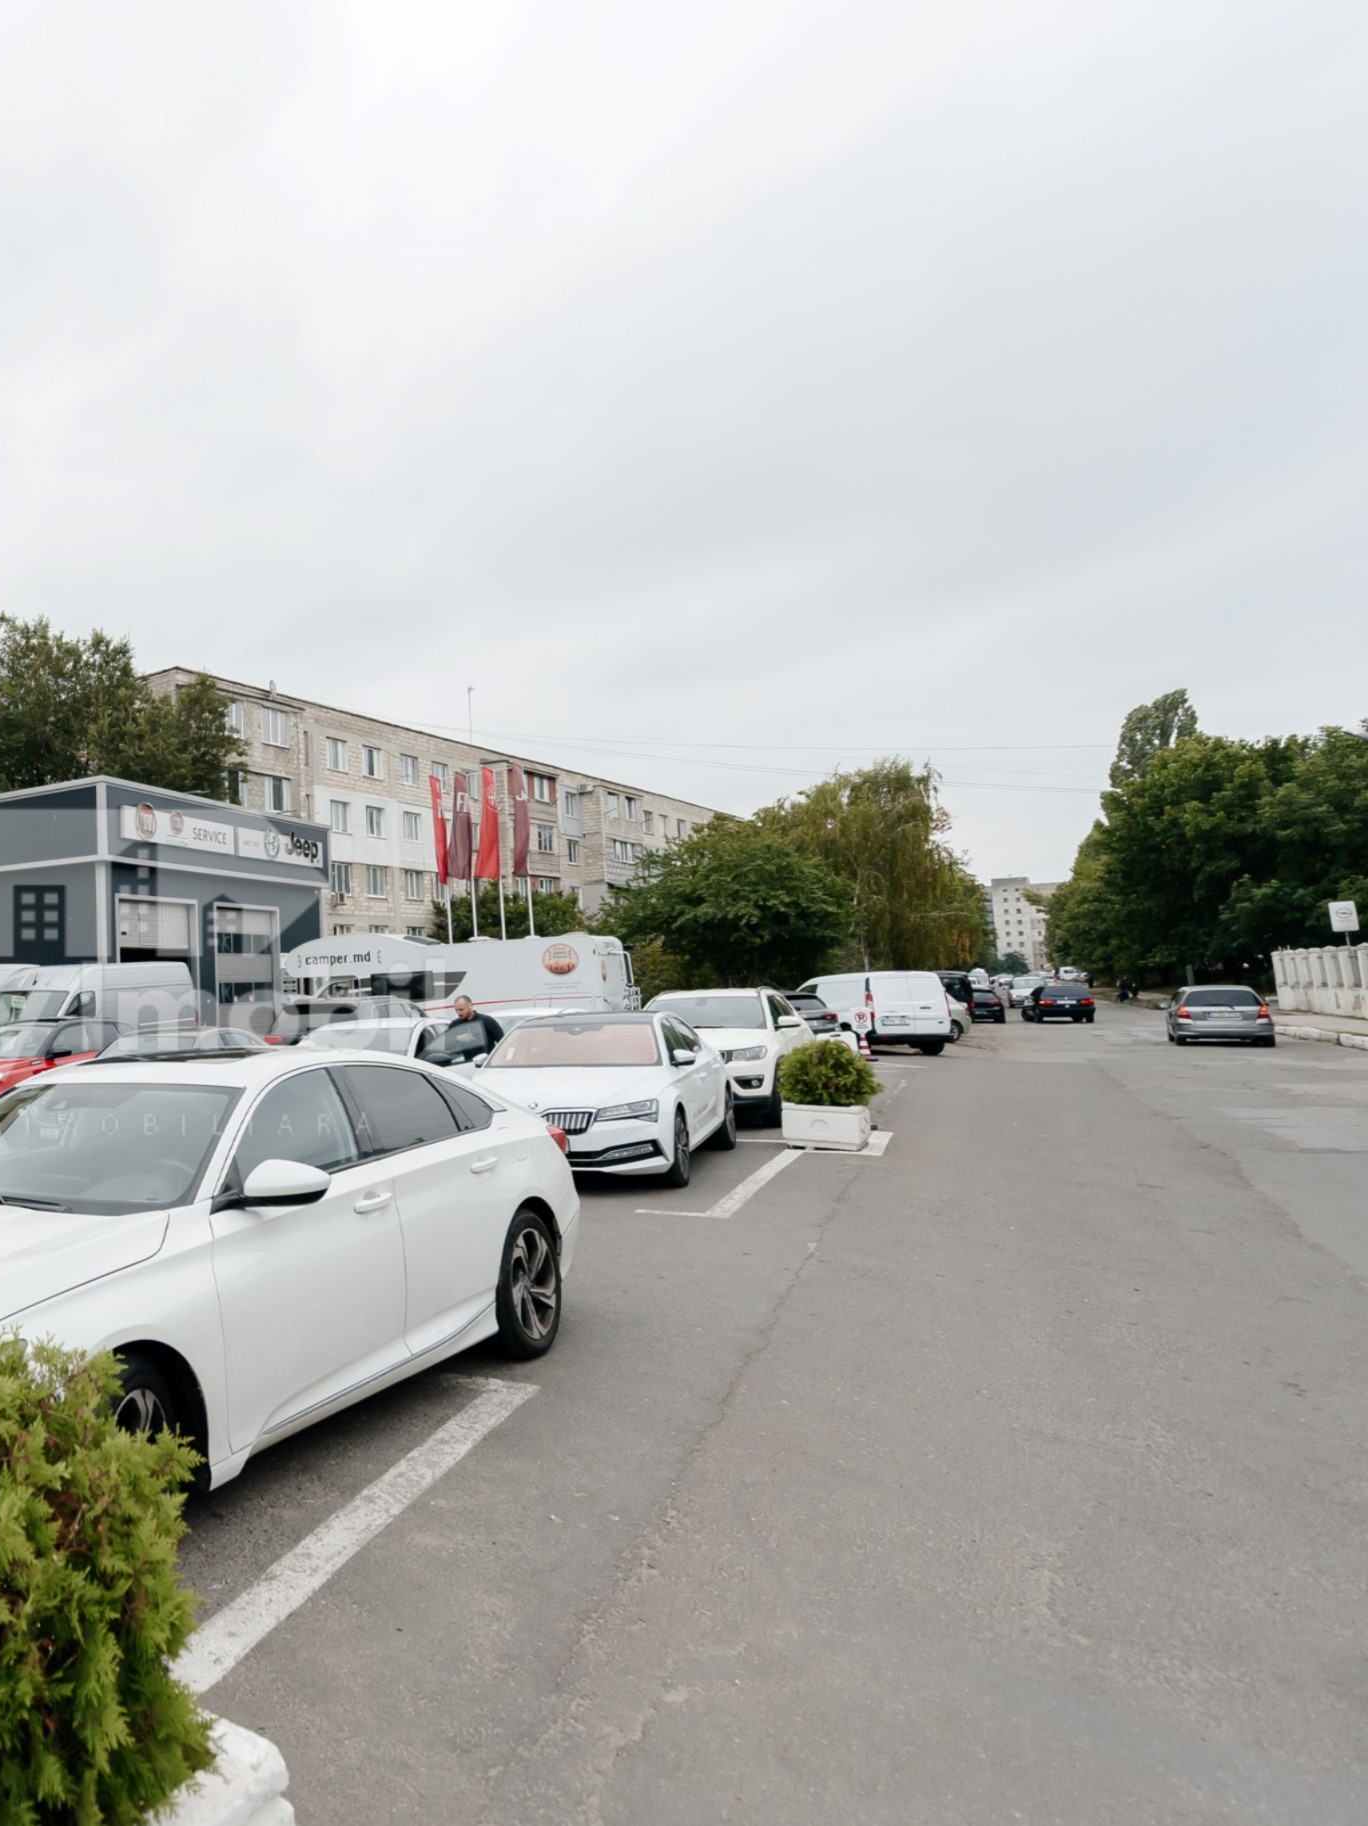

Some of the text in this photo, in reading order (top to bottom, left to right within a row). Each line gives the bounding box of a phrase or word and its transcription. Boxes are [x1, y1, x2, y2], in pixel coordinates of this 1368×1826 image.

[192, 826, 228, 846] SERVICE
[285, 831, 319, 863] Jeep
[305, 951, 371, 966] camper.md
